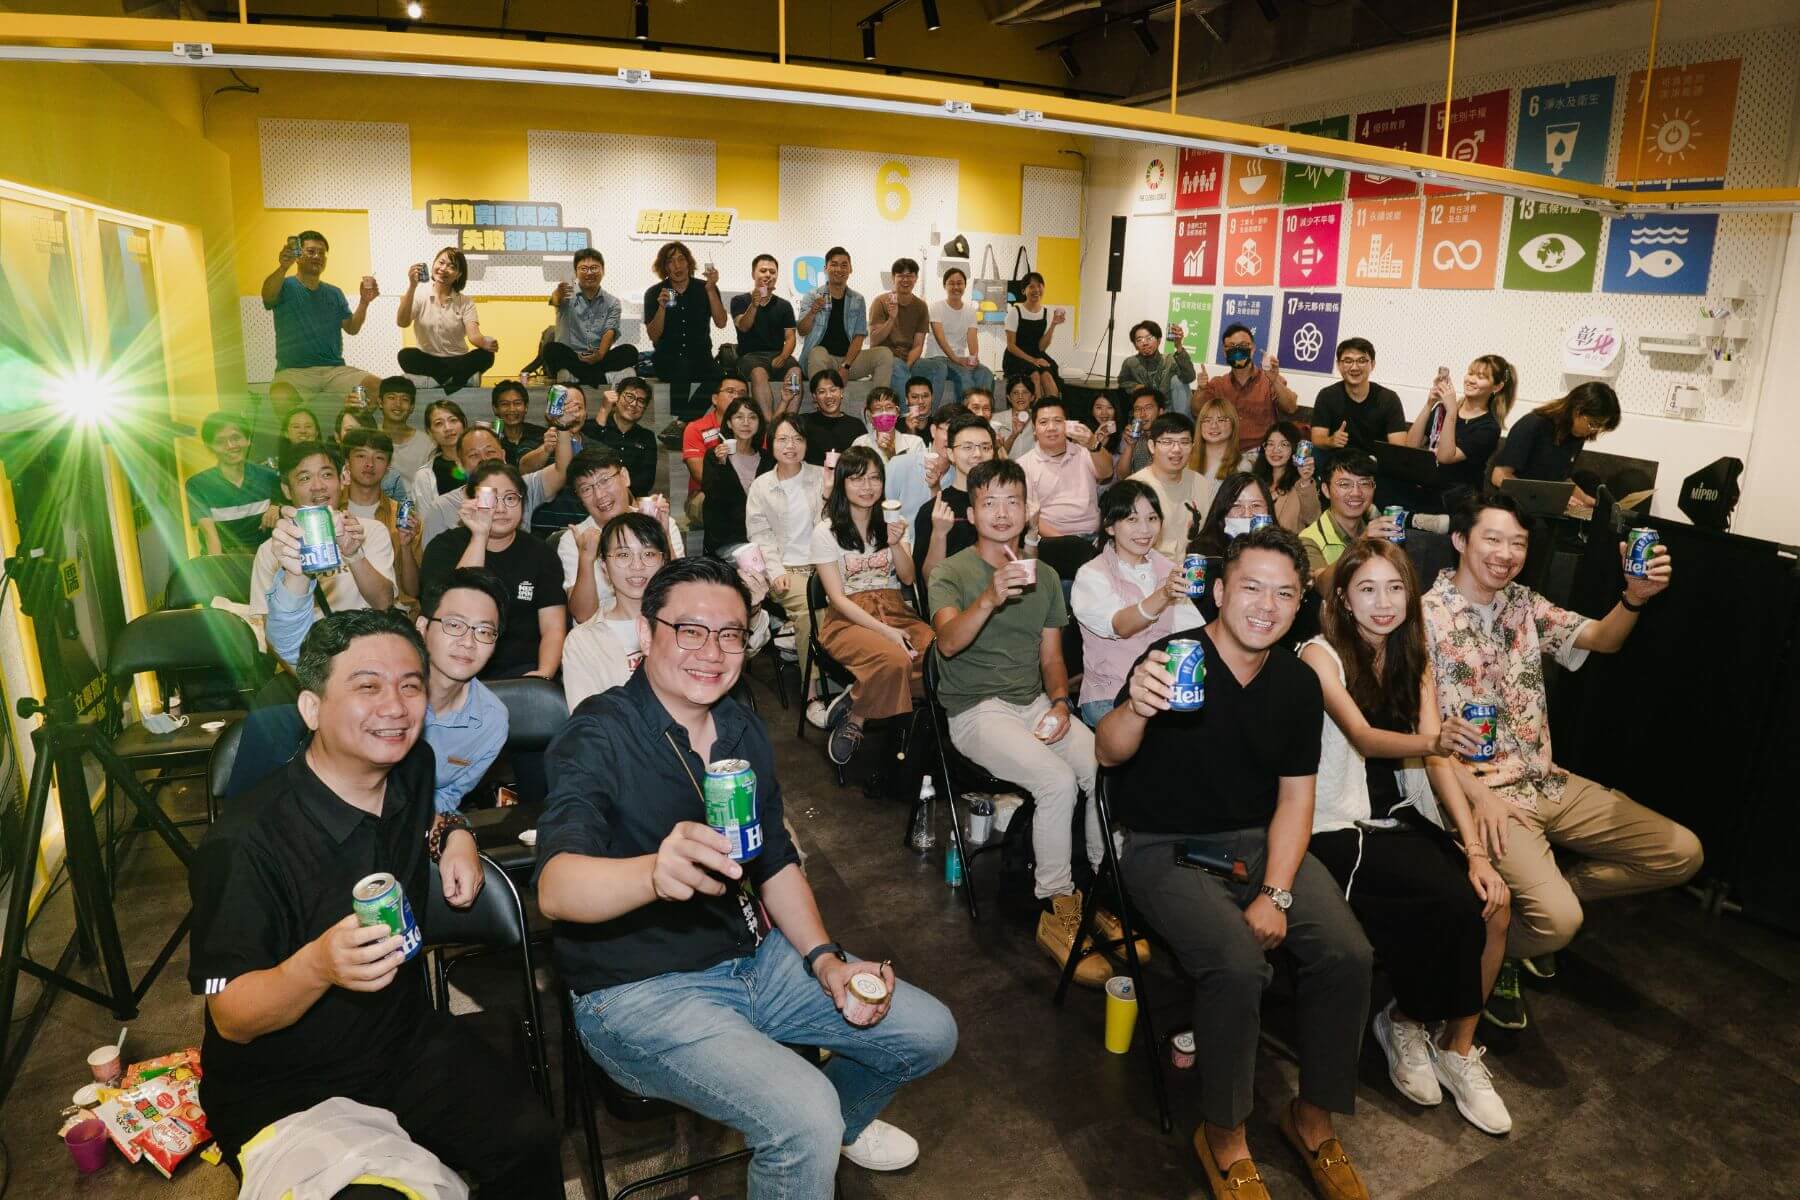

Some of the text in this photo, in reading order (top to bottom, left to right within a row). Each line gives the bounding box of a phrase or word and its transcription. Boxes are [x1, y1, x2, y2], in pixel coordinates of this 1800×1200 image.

[1529, 95, 1539, 117] 6
[1362, 120, 1370, 138] 4
[1437, 110, 1446, 130] 5
[876, 161, 912, 221] 6
[1357, 208, 1366, 227] 11
[1431, 205, 1443, 225] 12
[1519, 199, 1534, 219] 13
[1179, 221, 1184, 236] 8
[1230, 219, 1236, 234] 9
[1286, 215, 1297, 233] 10
[1172, 298, 1181, 311] 15
[1226, 299, 1235, 315] 16
[1288, 298, 1298, 315] 17
